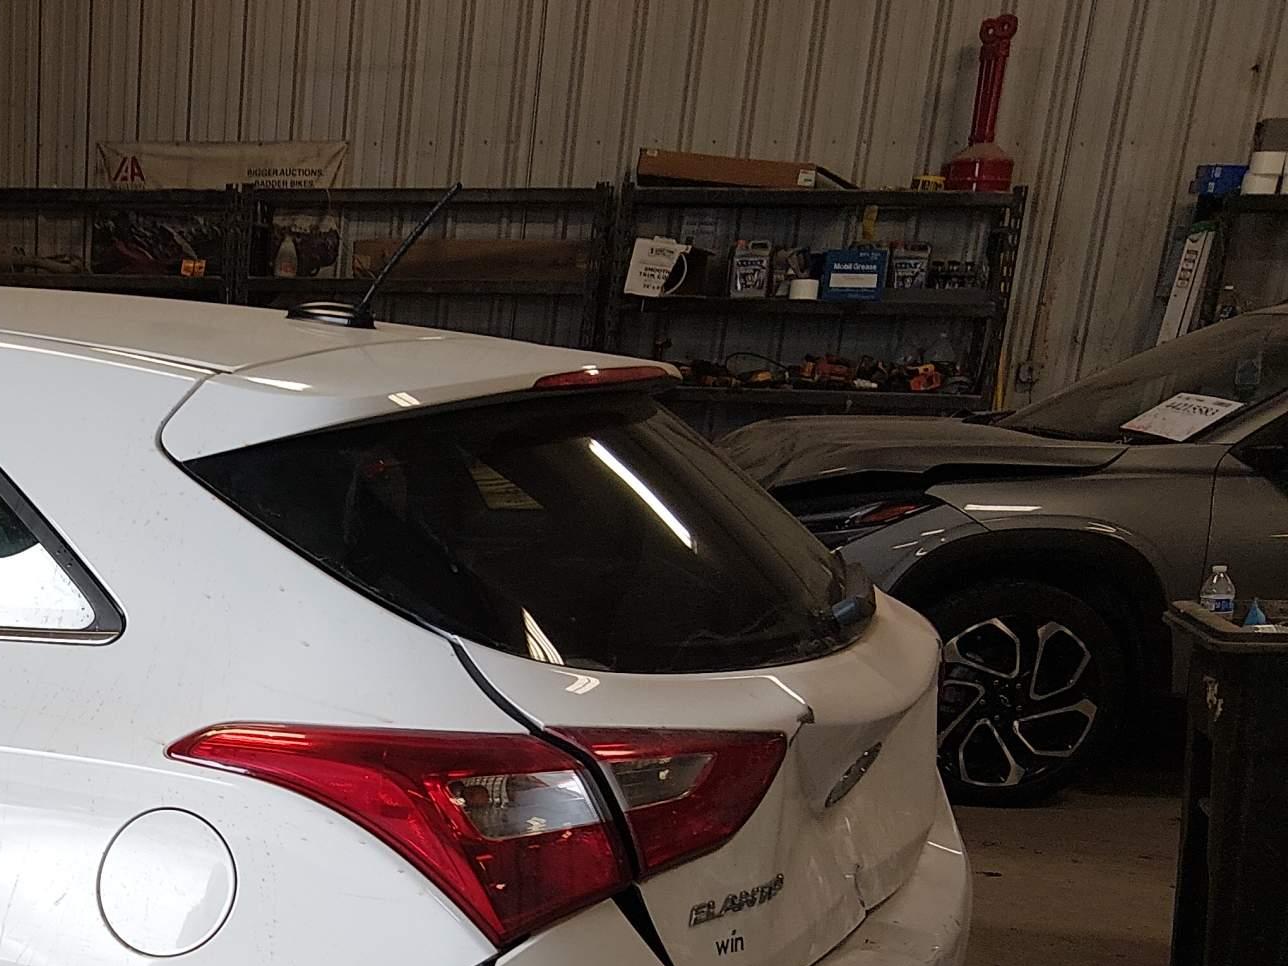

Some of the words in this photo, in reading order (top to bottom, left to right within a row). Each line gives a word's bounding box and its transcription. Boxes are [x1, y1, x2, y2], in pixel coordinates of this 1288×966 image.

[247, 167, 278, 177] BIGGER
[833, 262, 852, 270] Mobil
[853, 262, 877, 271] Grease
[715, 928, 745, 956] win
